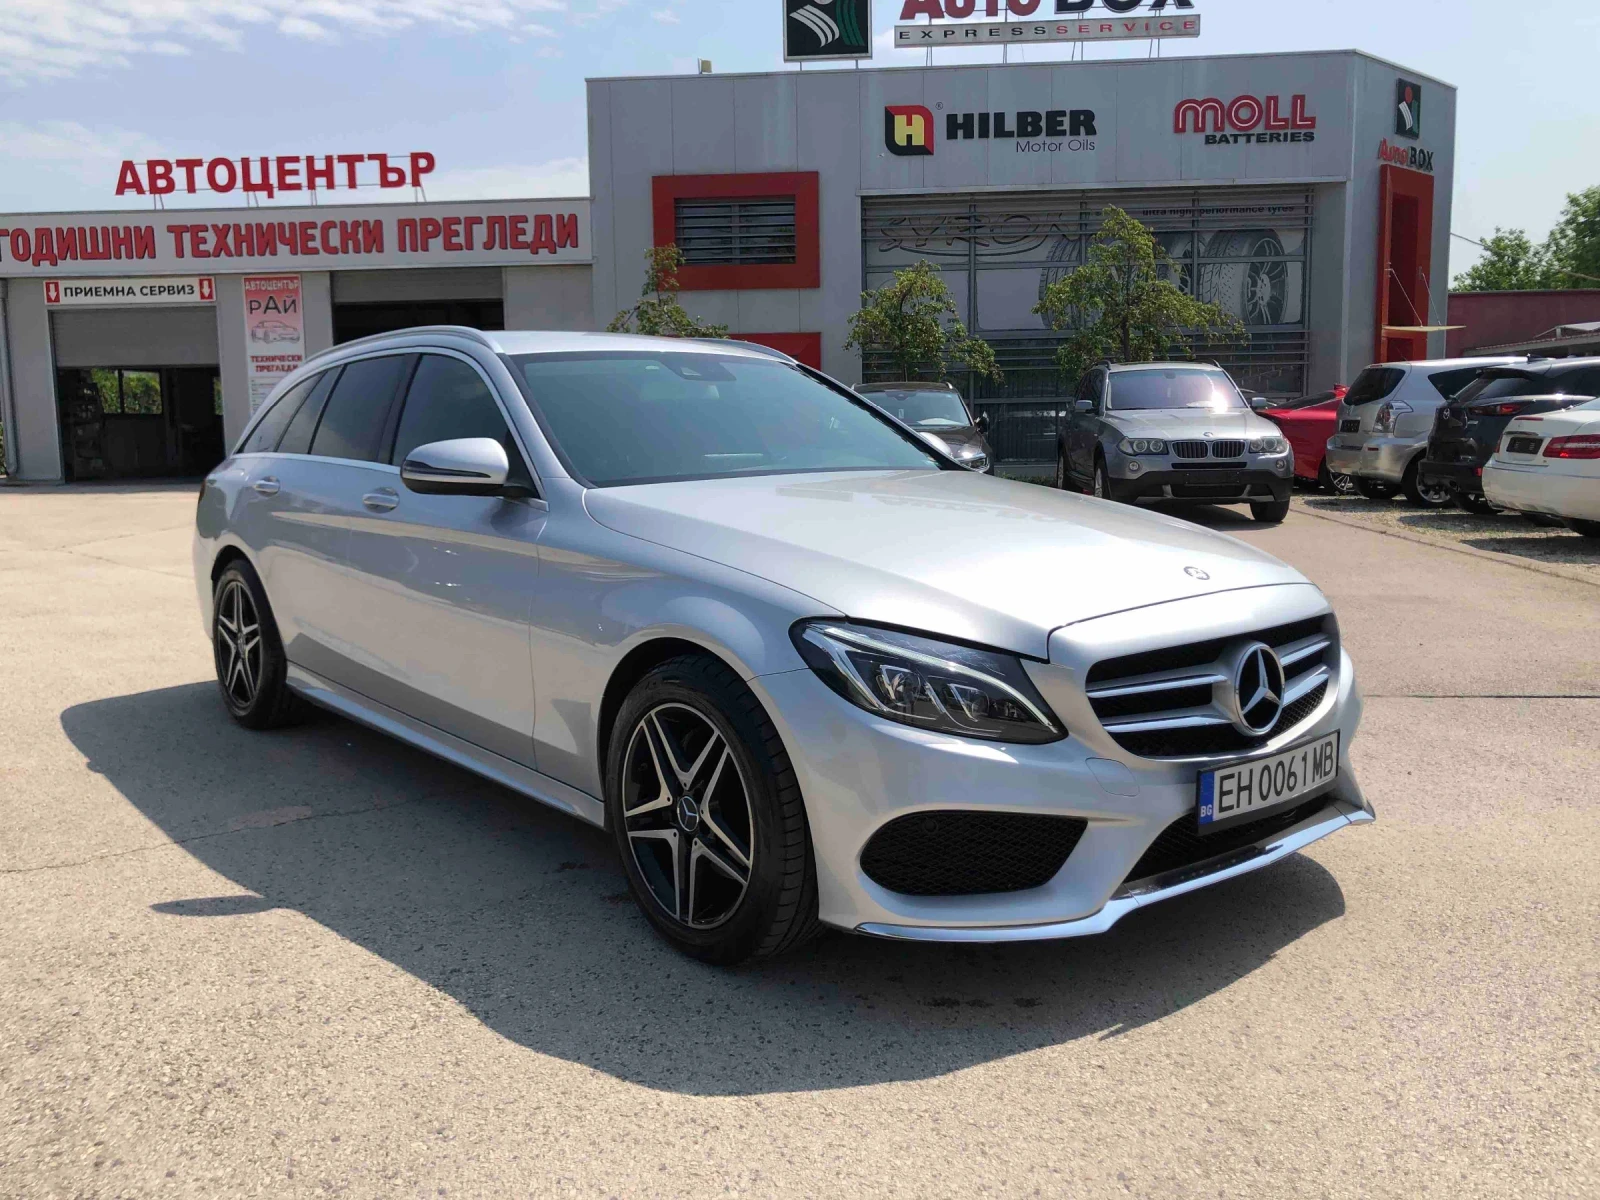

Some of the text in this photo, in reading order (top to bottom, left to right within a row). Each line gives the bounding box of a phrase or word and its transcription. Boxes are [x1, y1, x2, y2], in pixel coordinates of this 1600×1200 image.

[946, 109, 1097, 140] HILBER
[1204, 131, 1315, 145] BATTERIES
[1016, 139, 1096, 153] Motor Oils
[115, 151, 436, 199] АВТОЦЕНТЪР
[167, 220, 384, 259] ТЕХНИЧЕСКИ
[398, 213, 579, 255] ПРЕГЛЕДИ
[64, 285, 195, 297] ПРИЕМНА СЕРВИЗ
[245, 280, 299, 291] АВТОЦЕНТЪР
[249, 295, 297, 315] РАЙ
[1200, 804, 1213, 818] BG
